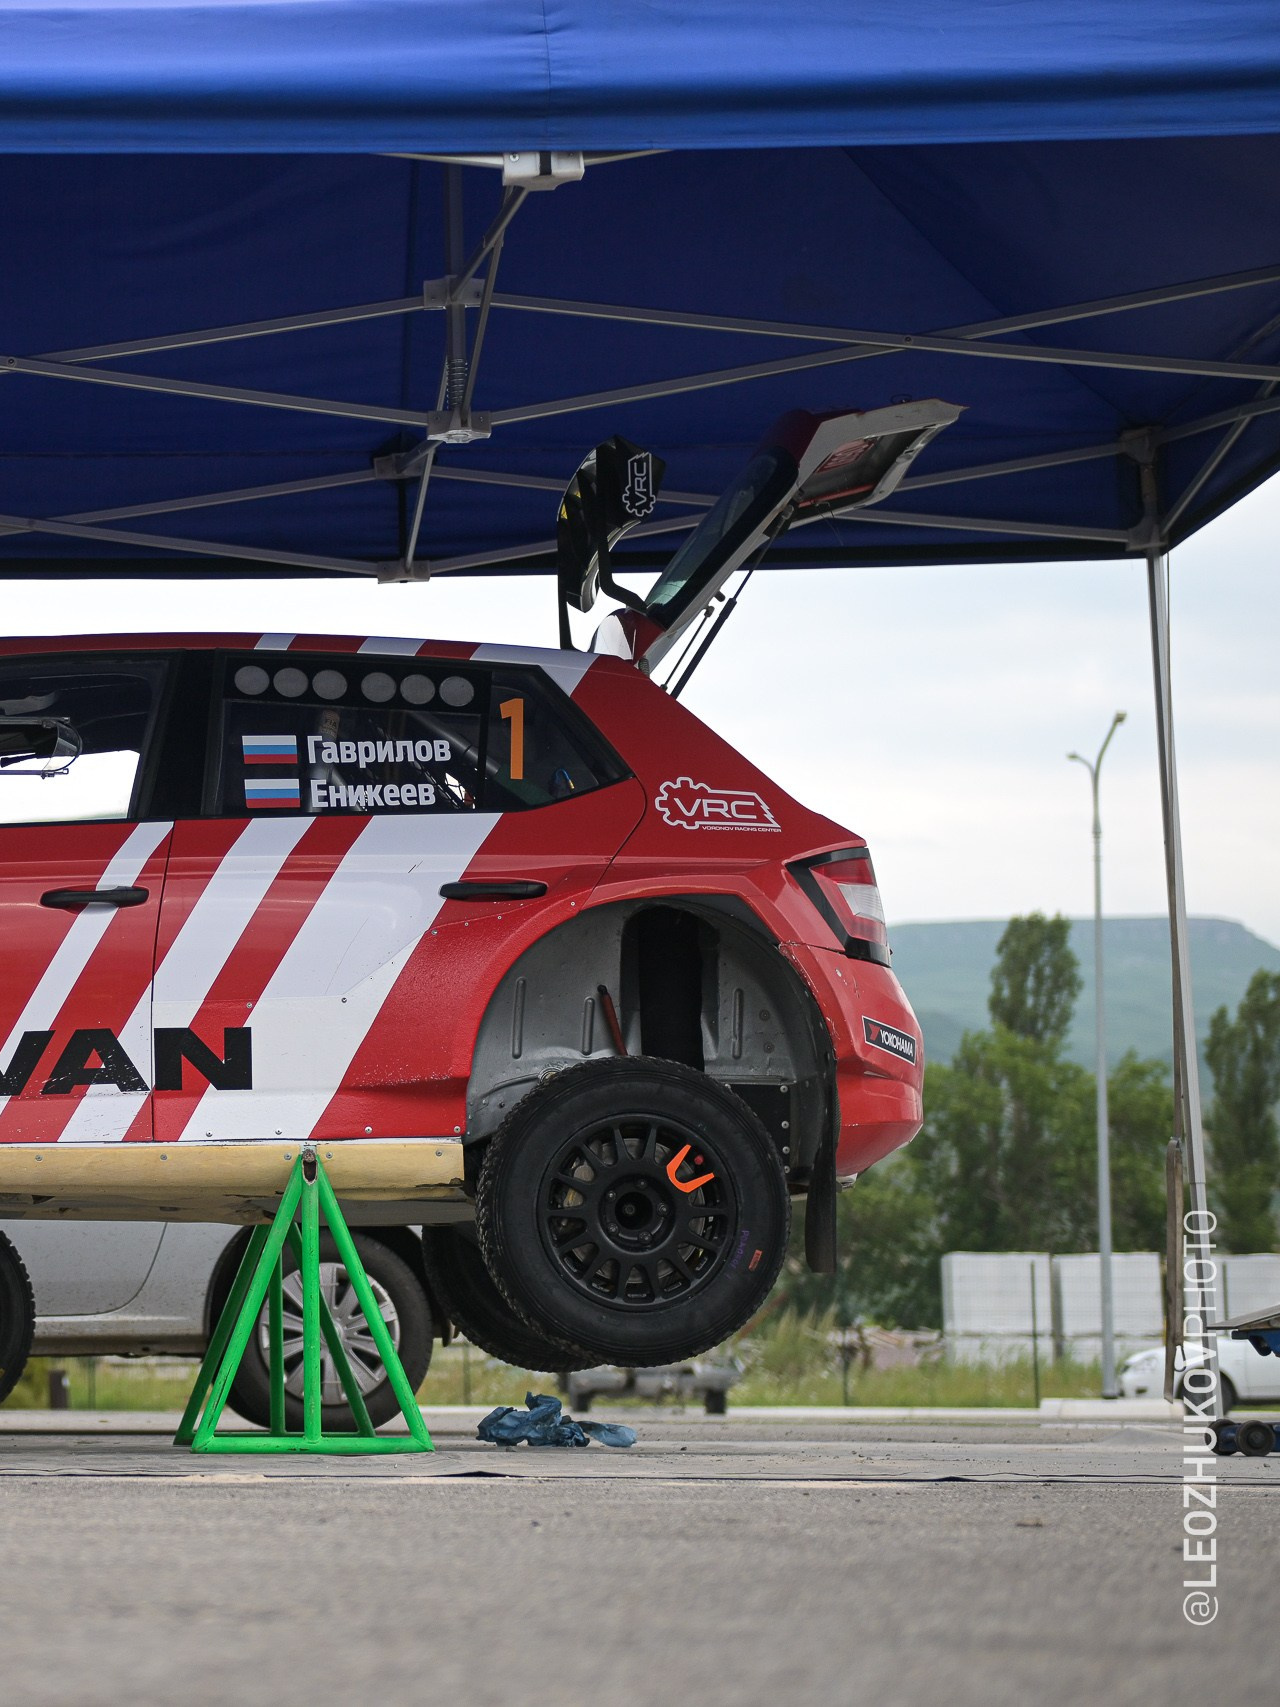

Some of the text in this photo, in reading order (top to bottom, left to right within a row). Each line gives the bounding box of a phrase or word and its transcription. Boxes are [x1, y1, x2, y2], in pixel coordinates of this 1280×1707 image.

[633, 462, 647, 506] VRC
[306, 735, 452, 768] Гаврилов
[499, 697, 524, 780] 1
[310, 778, 436, 808] Еникеев
[673, 797, 757, 819] VRC
[880, 1029, 914, 1057] YOKOHAMA
